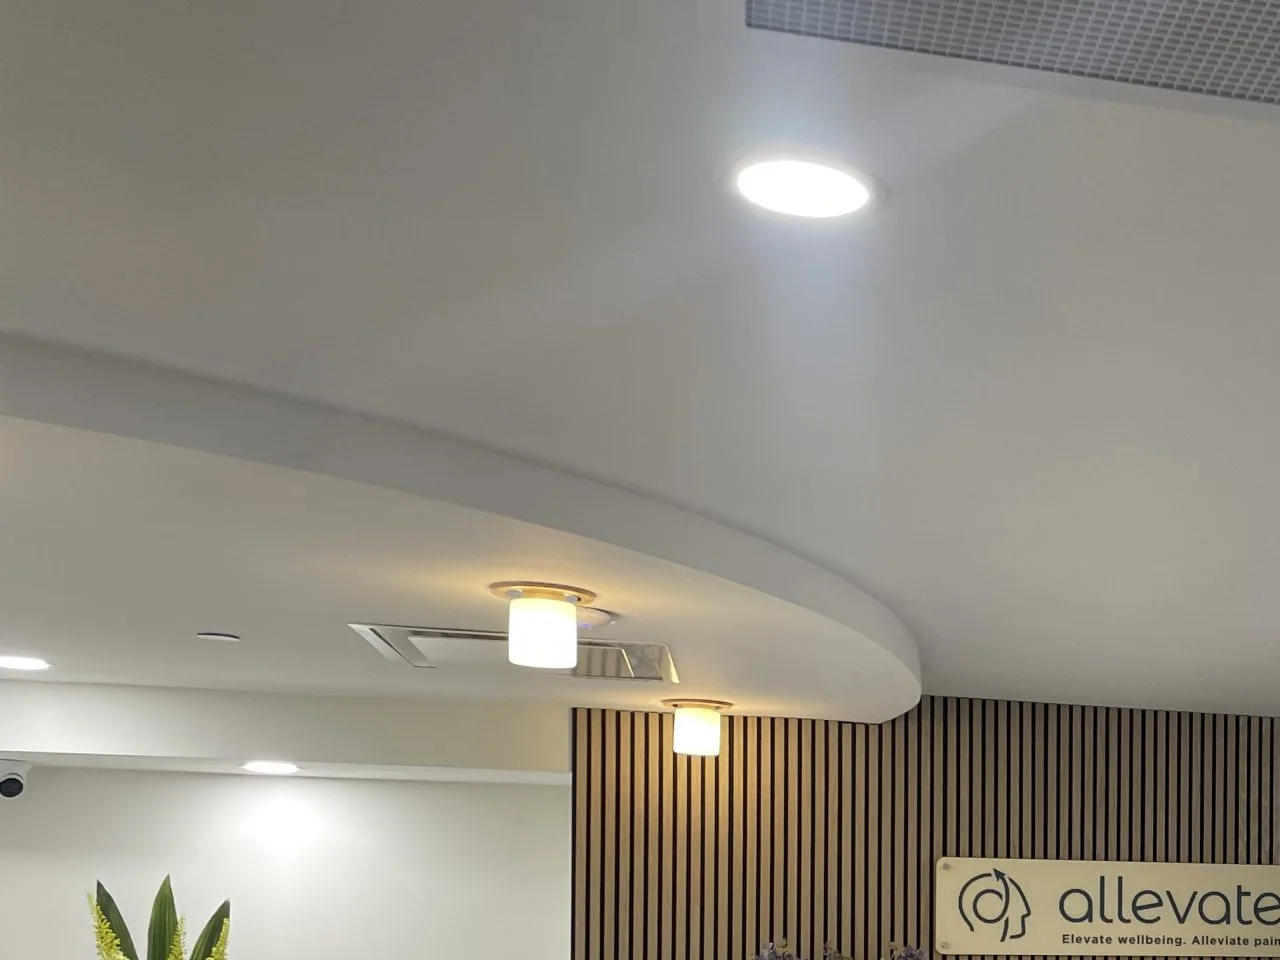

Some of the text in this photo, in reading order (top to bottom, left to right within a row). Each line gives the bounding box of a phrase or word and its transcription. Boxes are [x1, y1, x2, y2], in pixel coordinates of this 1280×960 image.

[1062, 934, 1113, 945] Elevate
[1117, 934, 1187, 947] wellbeing.
[1191, 935, 1250, 946] Alleviate
